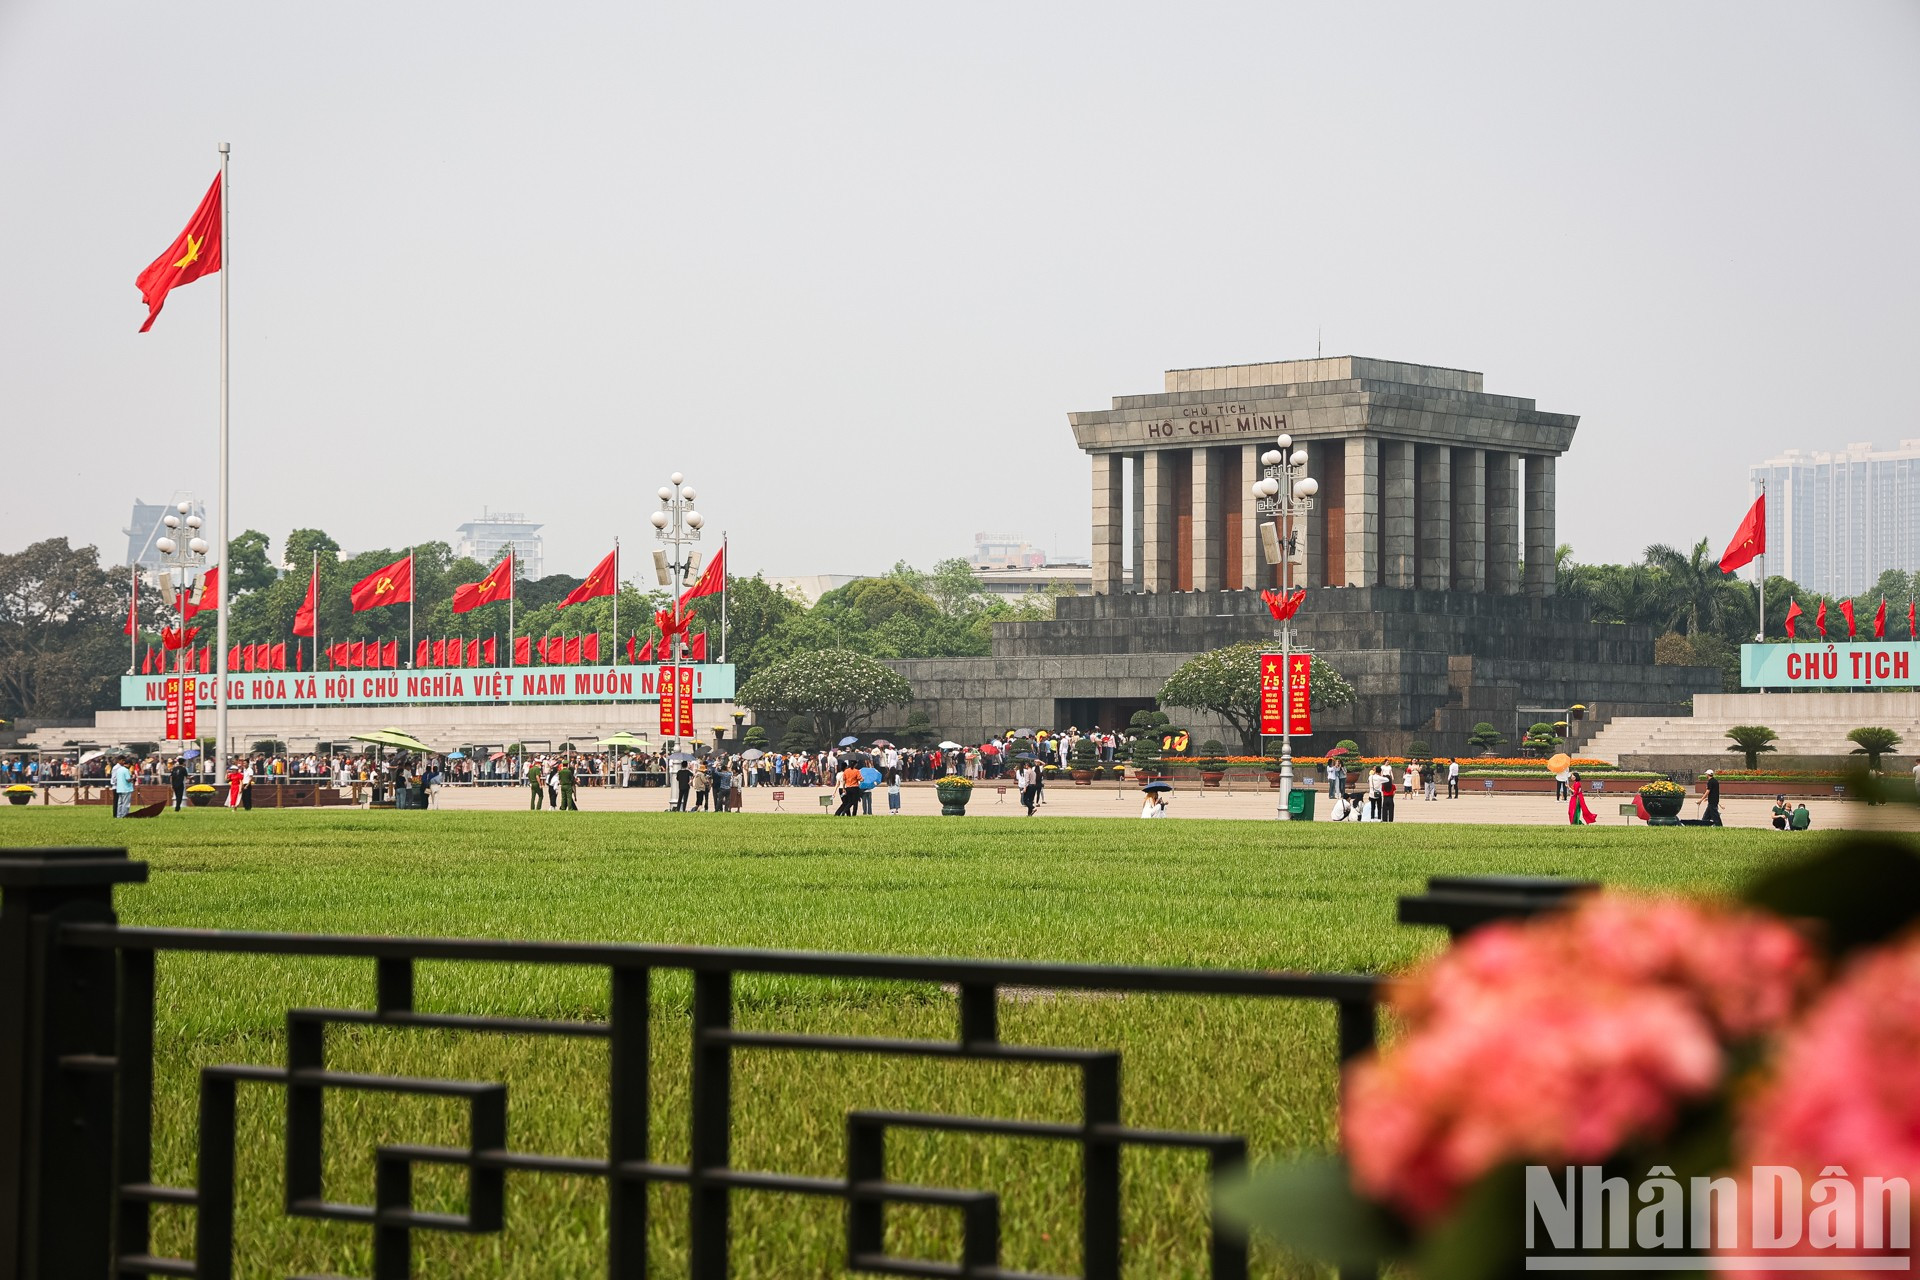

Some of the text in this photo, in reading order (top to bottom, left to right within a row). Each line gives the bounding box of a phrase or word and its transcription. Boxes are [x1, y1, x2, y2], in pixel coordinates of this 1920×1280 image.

[1787, 645, 1909, 685] CHỦ TỊCH
[253, 676, 287, 700] HÒA
[295, 675, 318, 699] XÃ
[326, 675, 355, 702] HỘI
[363, 671, 399, 698] CHỦ
[408, 672, 464, 697] NGHĨA
[474, 671, 515, 700] VIỆT
[523, 674, 566, 696] NAM
[576, 669, 633, 695] MUÔN
